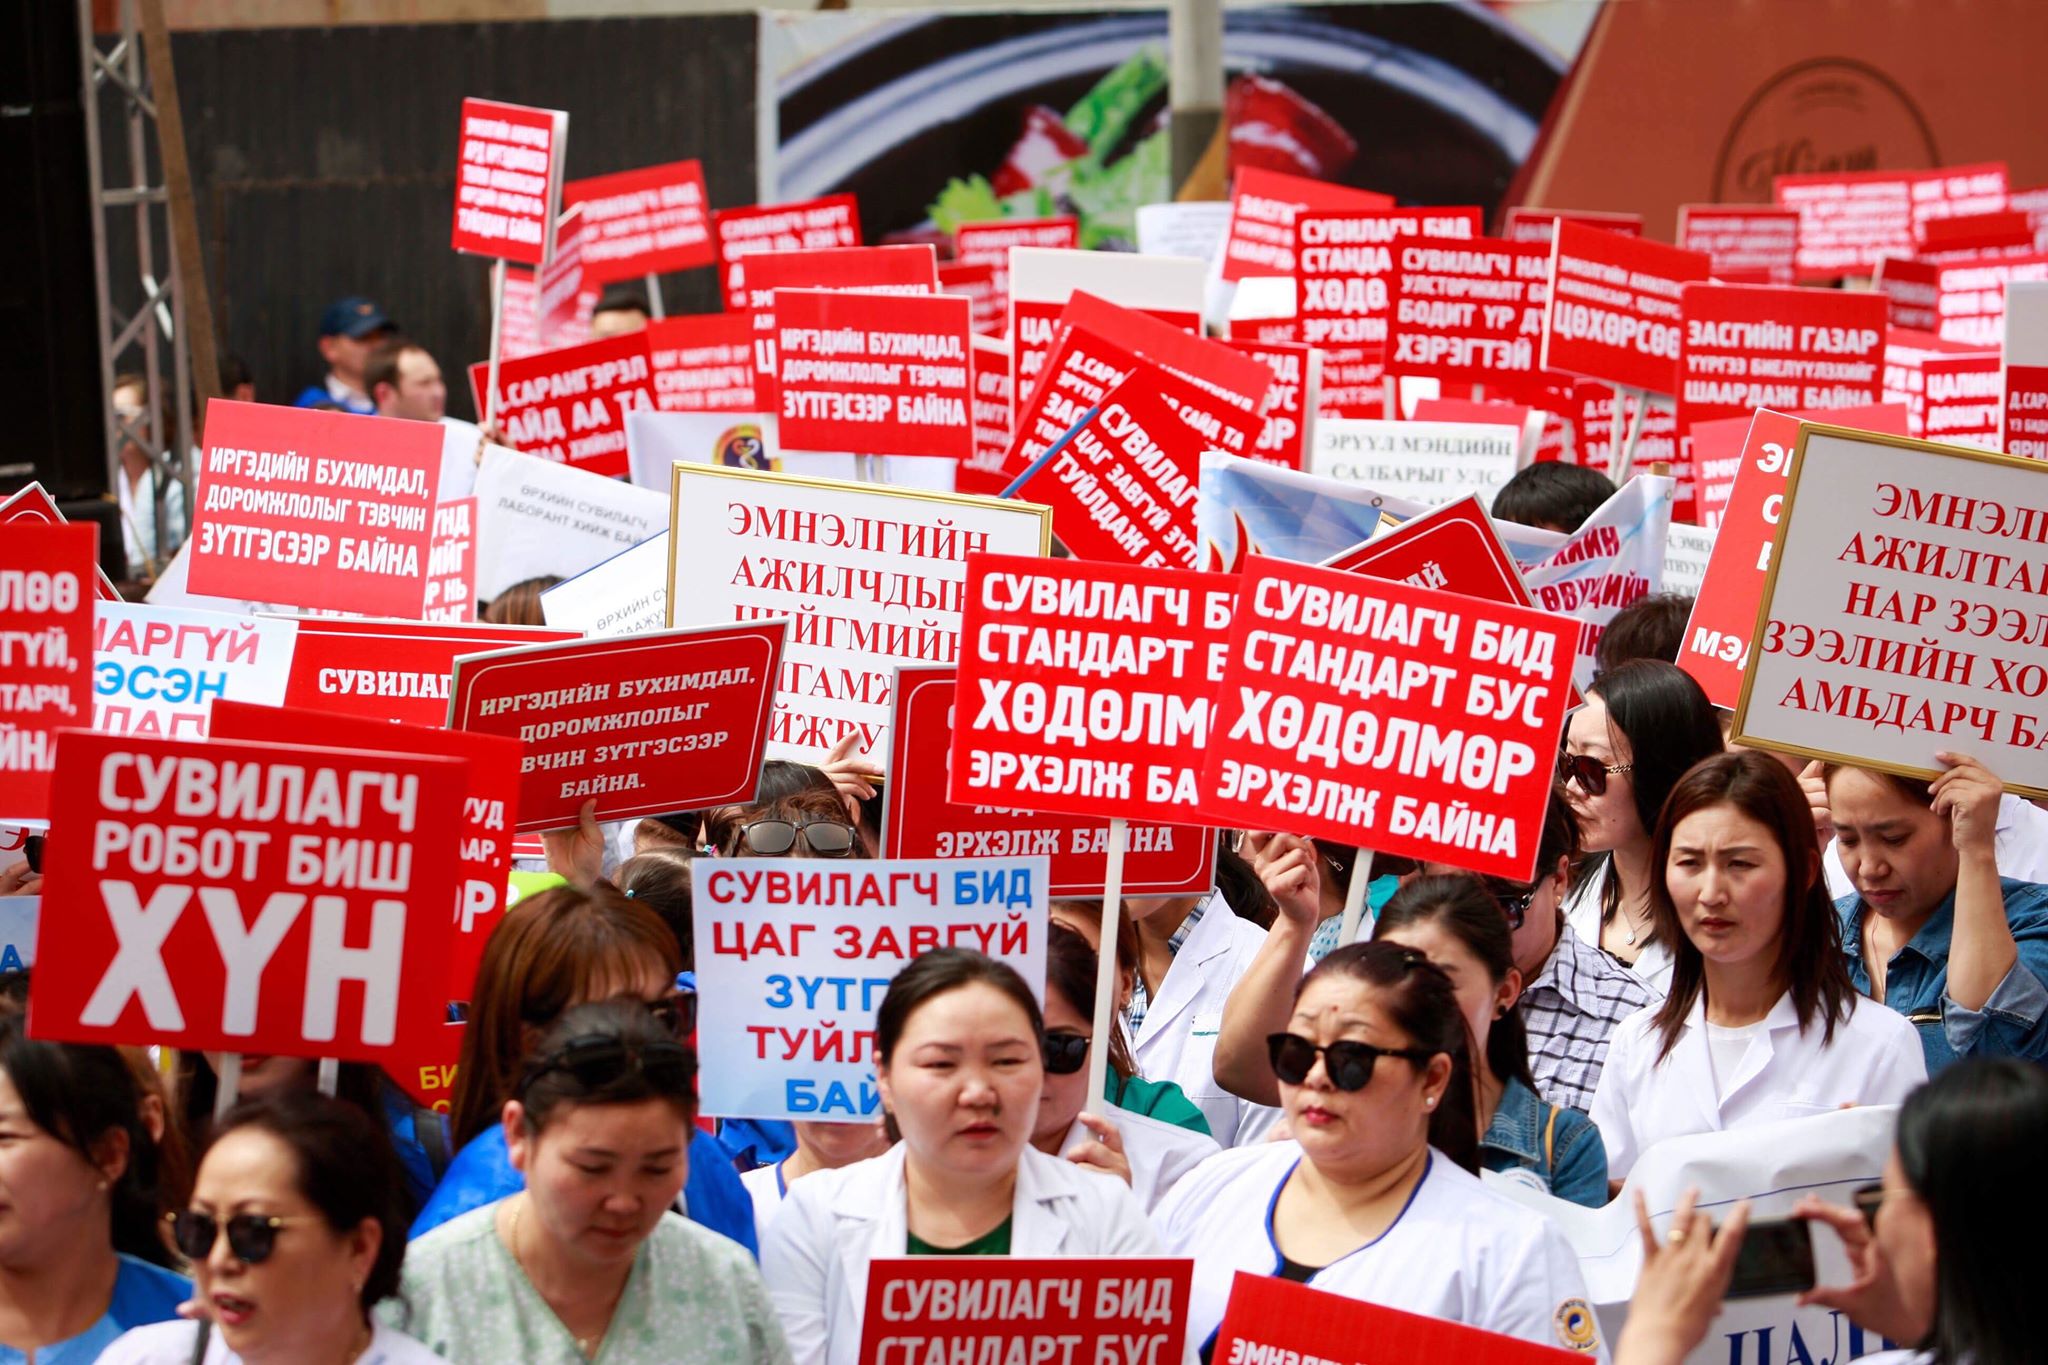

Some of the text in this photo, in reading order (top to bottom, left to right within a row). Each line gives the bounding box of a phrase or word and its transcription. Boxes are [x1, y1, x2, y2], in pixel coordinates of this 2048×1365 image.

[1401, 247, 1511, 277] СУВИЛАГЧ
[1398, 298, 1477, 329] БОДИТ
[781, 328, 965, 361] ИРГЭДИЙН БУХИМДАЛ,
[1394, 332, 1532, 372] ХЭРЭГТЭЙ
[1687, 319, 1879, 354] ЗАСГИЙН ГАЗАР
[782, 359, 966, 389] ДОРОМЖЛОЛЫГ ТЭВЧИН
[1686, 354, 1747, 377] ҮҮРГЭЭ
[572, 398, 612, 432] АА
[783, 390, 892, 422] ЗҮТГЭСЭЭР
[897, 393, 967, 426] БАЙНА
[1684, 380, 1874, 410] ШААРДАЖ БАЙНА
[1403, 434, 1513, 457] МЭНДИЙН
[209, 447, 430, 499] ИРГЭДИЙН БУХИМДАЛ,
[1074, 429, 1114, 465] ЦАГ
[1105, 463, 1172, 531] ЗАВГҮЙ
[1331, 463, 1450, 484] САЛБАРЫГ
[204, 484, 427, 532] ДОРОМЖЛОЛЫГ ТЭВЧИН
[498, 498, 570, 527] ЛАБОРАНТ
[578, 502, 649, 530] СУВИЛАГЧ
[1052, 450, 1149, 557] ТУЙЛДАЖ
[200, 522, 419, 577] ЗҮТГЭСЭЭР БАЙНА
[728, 501, 990, 562] ЭМНЭЛГИЙН
[982, 572, 1240, 630] СУВИЛАГЧ Б
[1842, 582, 1937, 626] НАР
[1253, 576, 1461, 654] СУВИЛАГЧ
[1470, 619, 1557, 681] БИД
[978, 623, 1193, 679] СТАНДАРТ
[1762, 618, 1979, 687] ЗЭЭЛИЙН
[479, 683, 611, 716] ИРГЭДИЙН
[1243, 630, 1549, 728] СТАНДАРТ БУС
[519, 703, 710, 742] ДОРОМЖЛОЛЫГ
[973, 678, 1218, 749] ХӨДӨЛМ
[1779, 676, 2000, 742] АМЬДАРЧ
[593, 731, 729, 764] ЗҮТГЭСЭЭР
[1228, 687, 1536, 796] ХӨДӨЛМӨР
[99, 752, 419, 833] СУВИЛАГЧ
[559, 773, 647, 799] БАЙНА.
[968, 750, 1200, 806] ЭРХЭЛЖ БА
[1216, 760, 1519, 859] ЭРХЭЛЖ БАЙНА
[93, 820, 271, 882] РОБОТ
[287, 835, 412, 893] БИШ
[936, 829, 1060, 858] ЭРХЭЛЖ
[453, 879, 497, 933] Р
[707, 868, 1033, 910] СУВИЛАГЧ БИД
[713, 922, 816, 961] ЦАГ
[79, 879, 407, 1047] ХҮН
[764, 975, 892, 1012] ЗҮТГ
[881, 1277, 1174, 1325] СУВИЛАГЧ БИД
[875, 1333, 1170, 1365] СТАНДАРТ БУС
